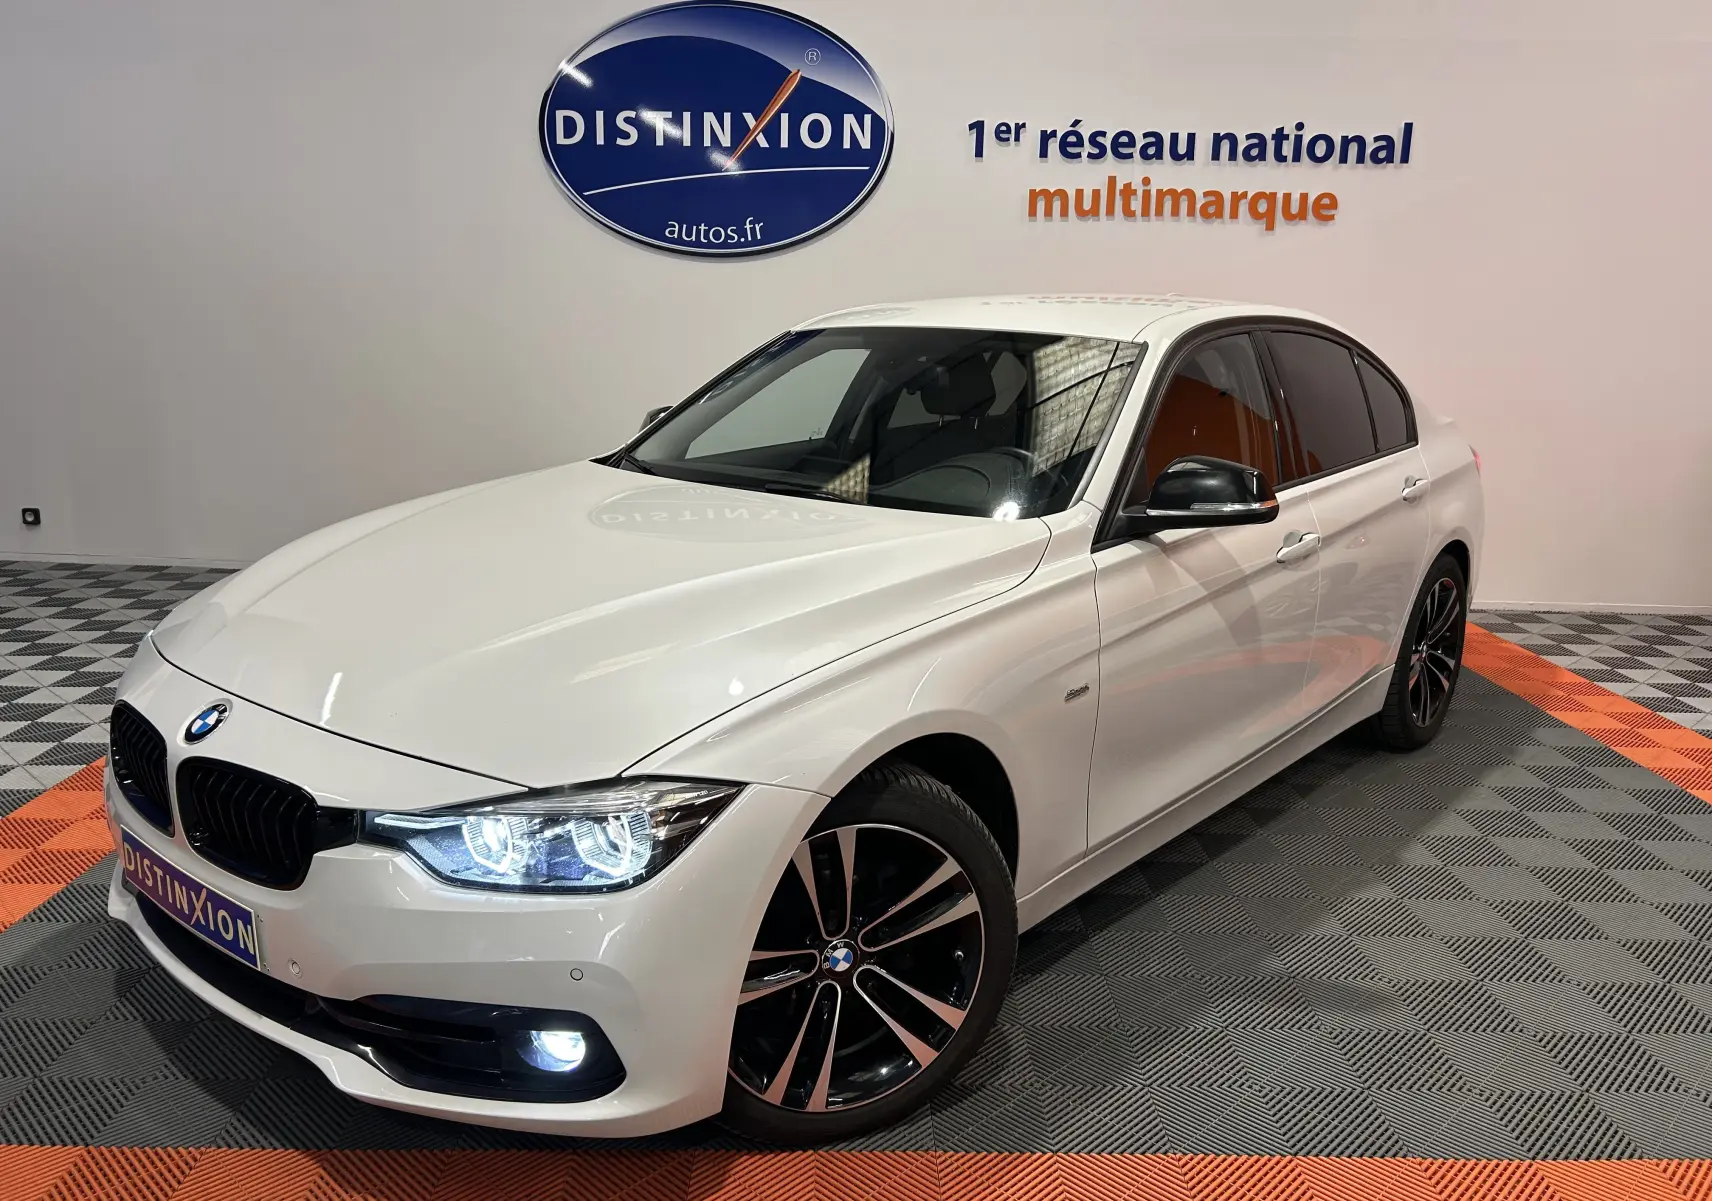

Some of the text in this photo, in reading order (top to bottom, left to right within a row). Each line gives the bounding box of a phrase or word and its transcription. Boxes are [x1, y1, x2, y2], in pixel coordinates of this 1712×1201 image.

[555, 109, 873, 150] DISTINXION
[967, 119, 1414, 165] 1er réseau national
[1027, 175, 1339, 232] multimarque
[664, 216, 764, 244] autos.fr
[124, 843, 255, 954] DISTINXION
